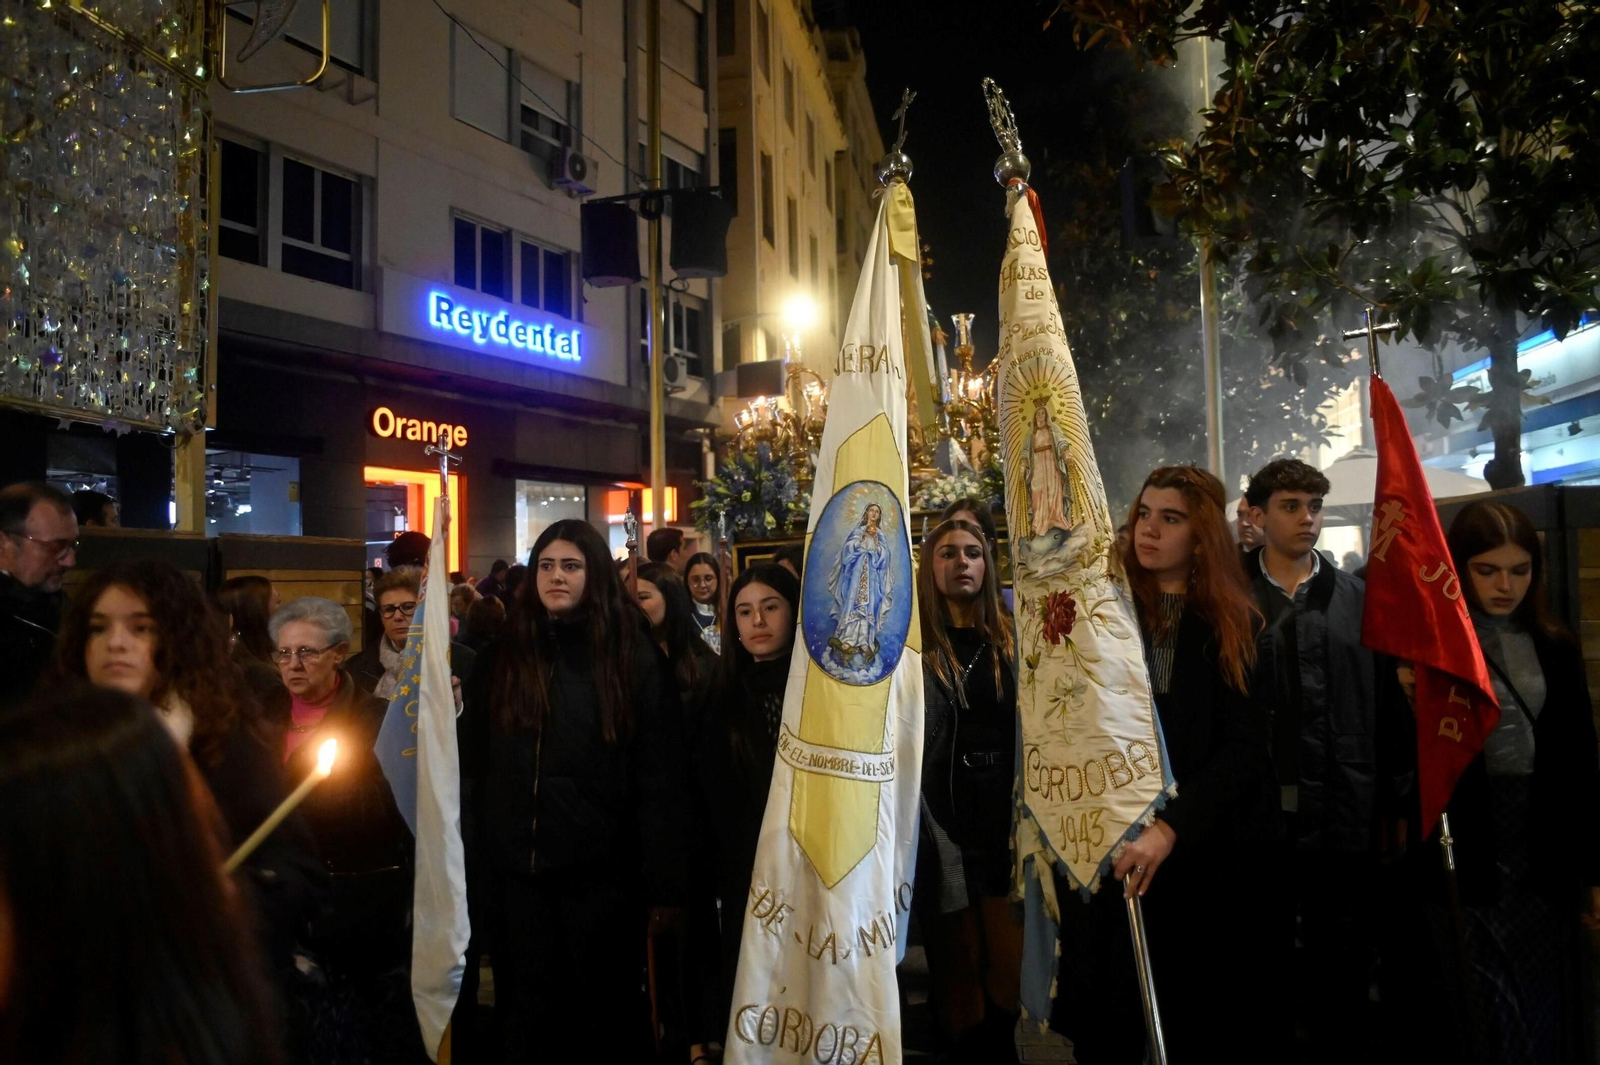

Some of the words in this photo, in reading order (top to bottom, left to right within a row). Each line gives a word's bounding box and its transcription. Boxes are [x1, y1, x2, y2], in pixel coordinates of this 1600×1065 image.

[1025, 285, 1044, 300] de
[429, 291, 582, 361] Reydental
[1009, 349, 1036, 369] ROGAD
[1038, 346, 1055, 357] POR
[373, 406, 468, 451] Orange
[1419, 561, 1463, 601] JU
[1026, 740, 1158, 803] CORDOBA
[1059, 808, 1105, 865] 1943
[750, 886, 795, 936] DE
